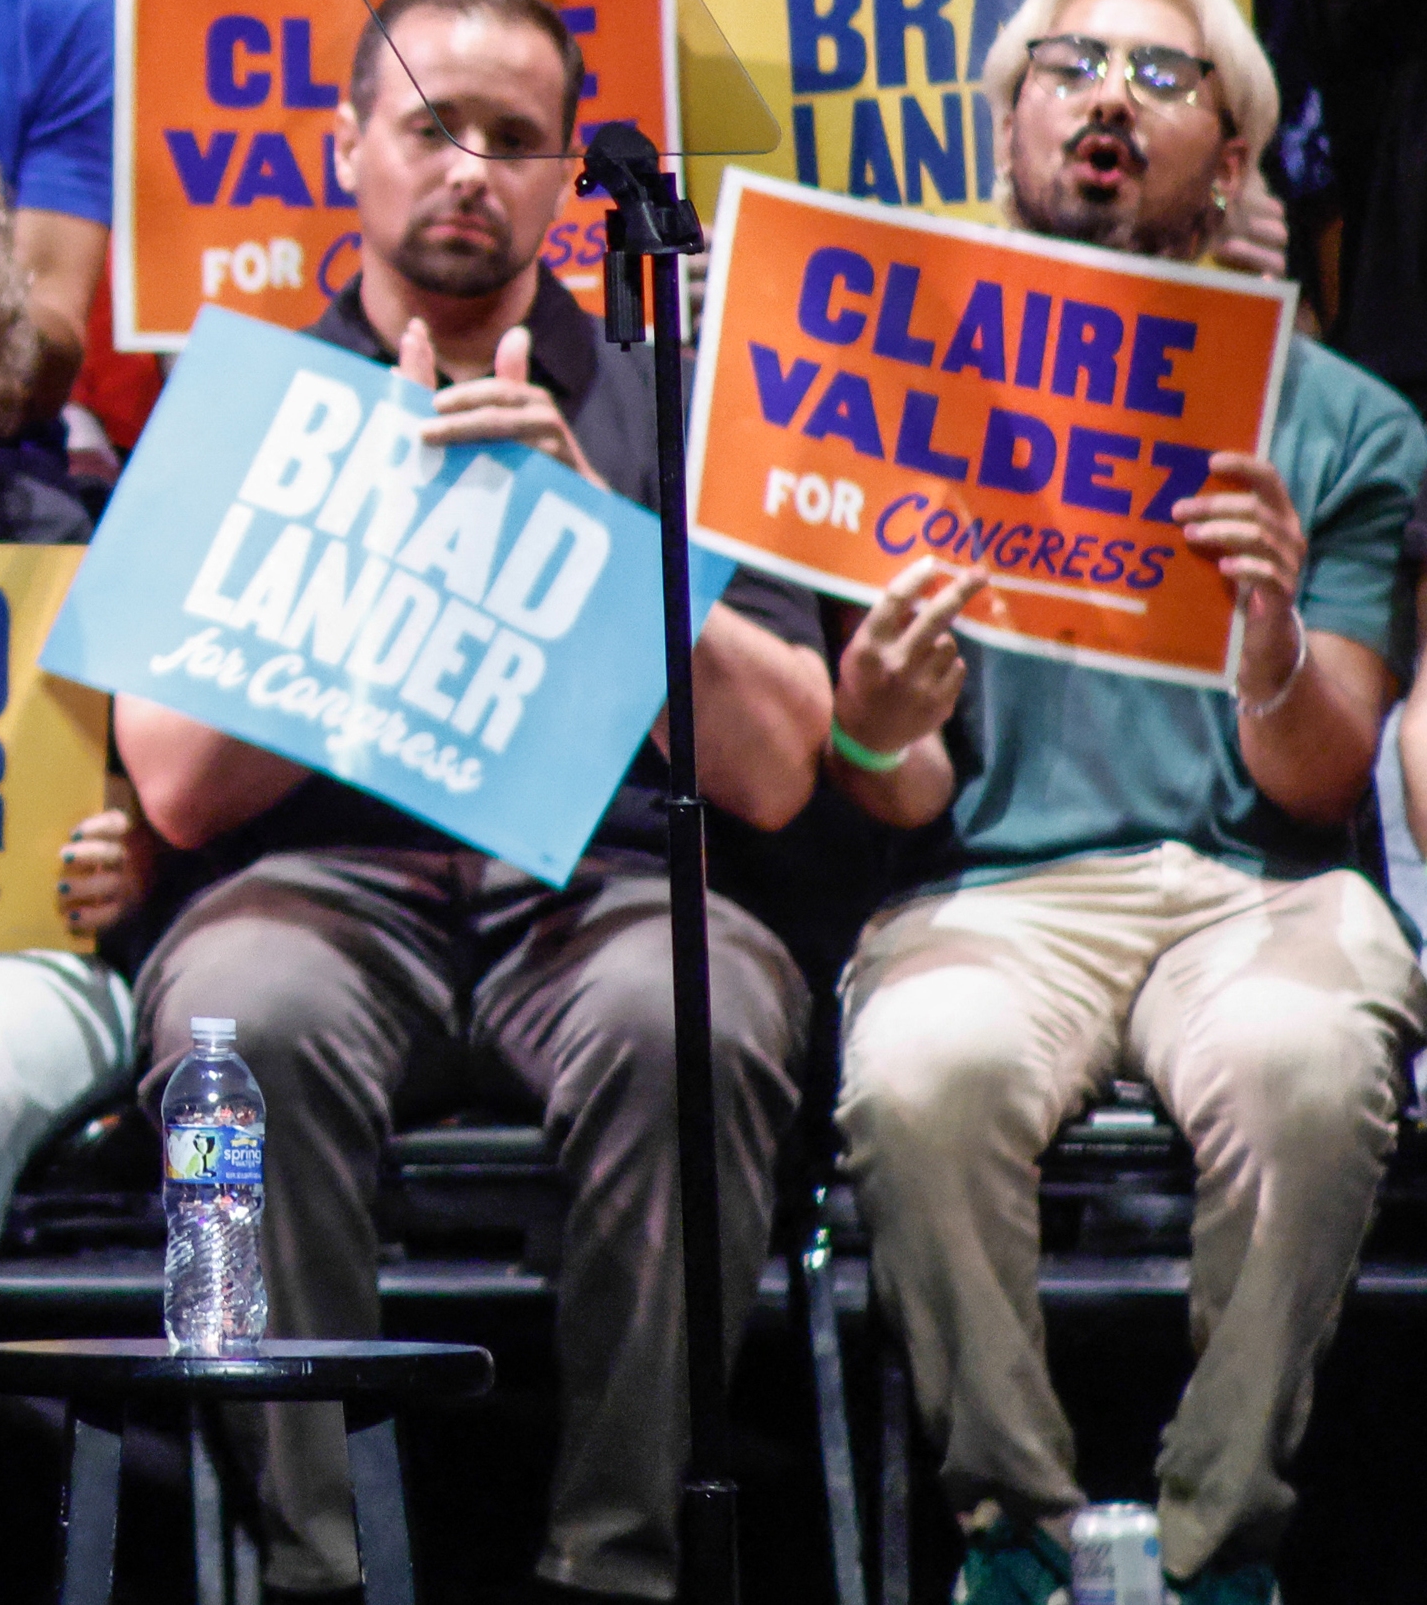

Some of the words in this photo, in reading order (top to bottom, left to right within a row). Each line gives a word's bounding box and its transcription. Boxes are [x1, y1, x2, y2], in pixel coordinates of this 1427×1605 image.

[201, 237, 305, 297] FOR
[797, 246, 1199, 418] CLAIRE
[237, 369, 611, 641] BRAD
[748, 341, 1216, 526] VALDEZ
[764, 467, 865, 534] FOR
[874, 492, 1175, 590] CONGRESS
[150, 627, 247, 688] for
[246, 653, 483, 791] Congress
[183, 502, 546, 755] LANDER
[223, 1148, 262, 1167] spring
